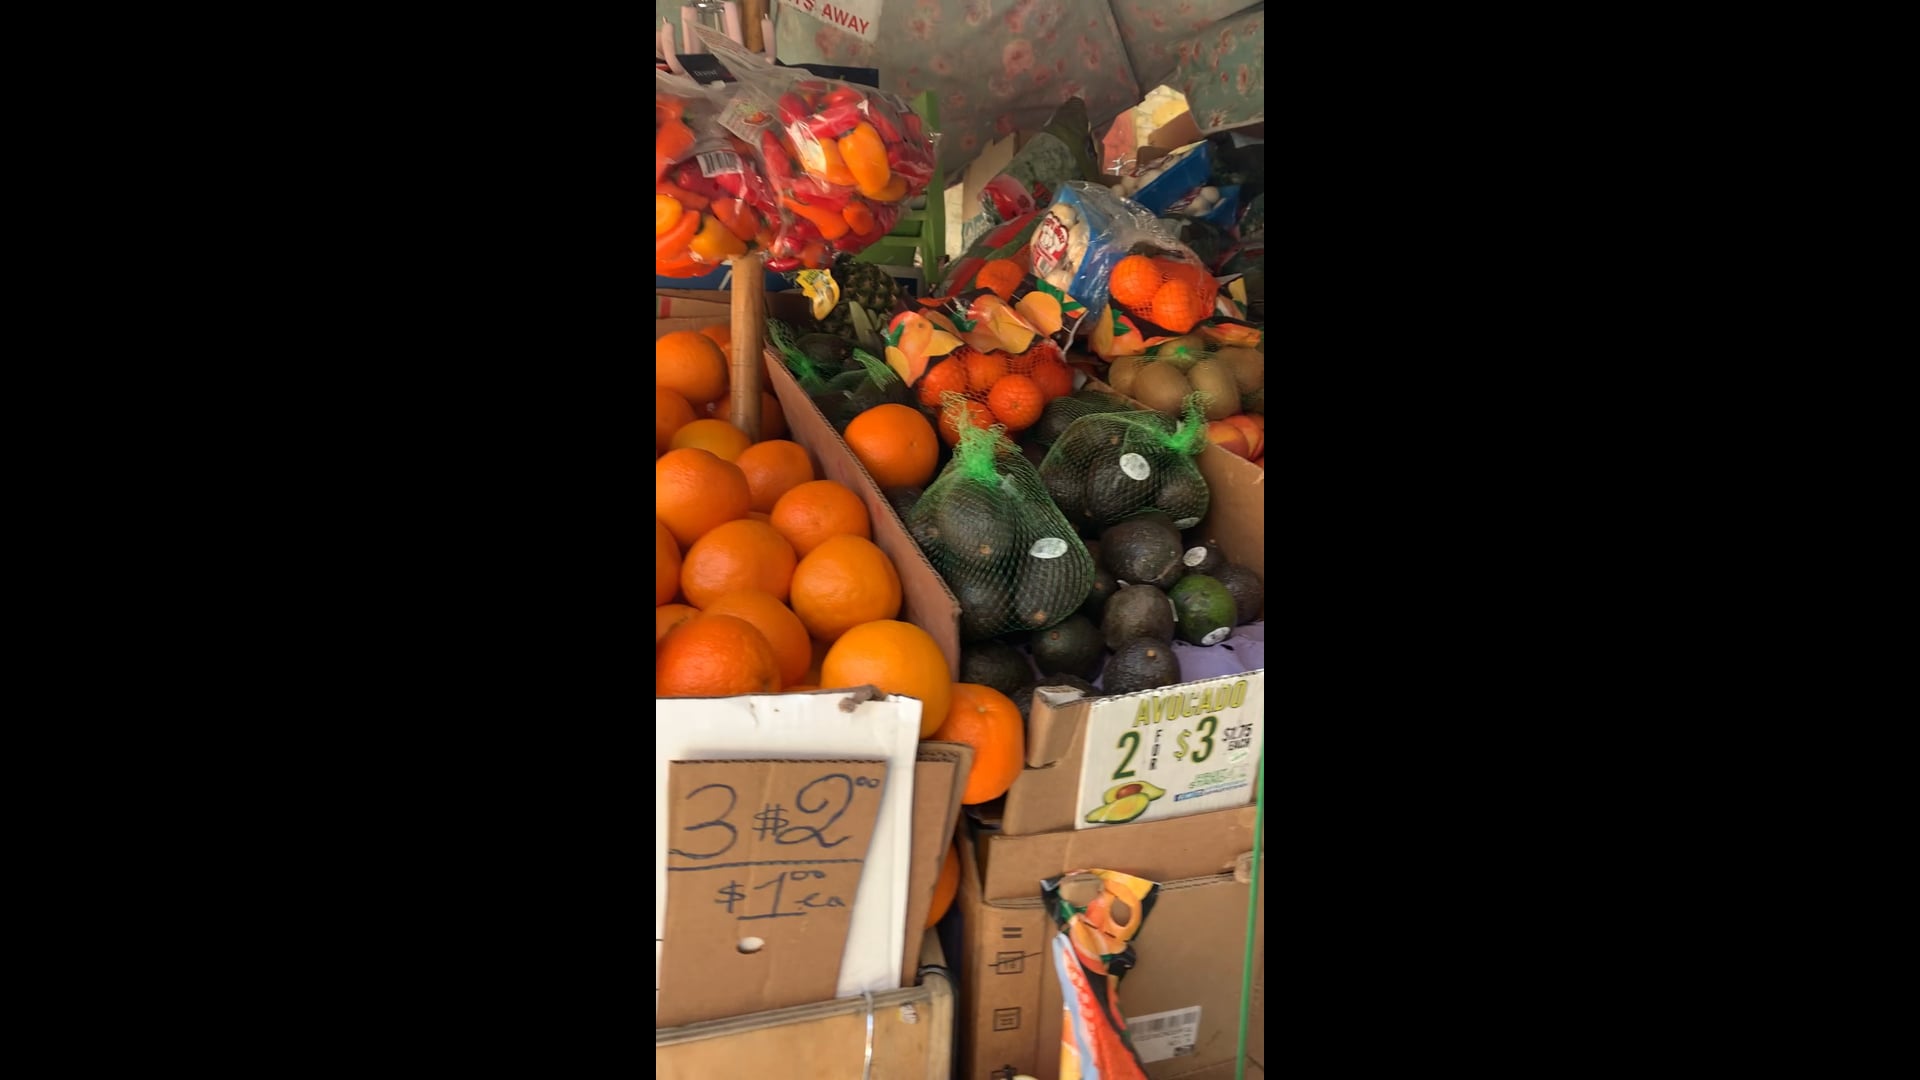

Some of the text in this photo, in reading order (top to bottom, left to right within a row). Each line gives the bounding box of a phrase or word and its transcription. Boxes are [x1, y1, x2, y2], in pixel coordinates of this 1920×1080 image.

[822, 3, 870, 35] AWAY
[1132, 680, 1248, 728] AVOCADO
[1111, 730, 1142, 780] 2
[1173, 715, 1219, 763] $3
[668, 783, 738, 860] 3
